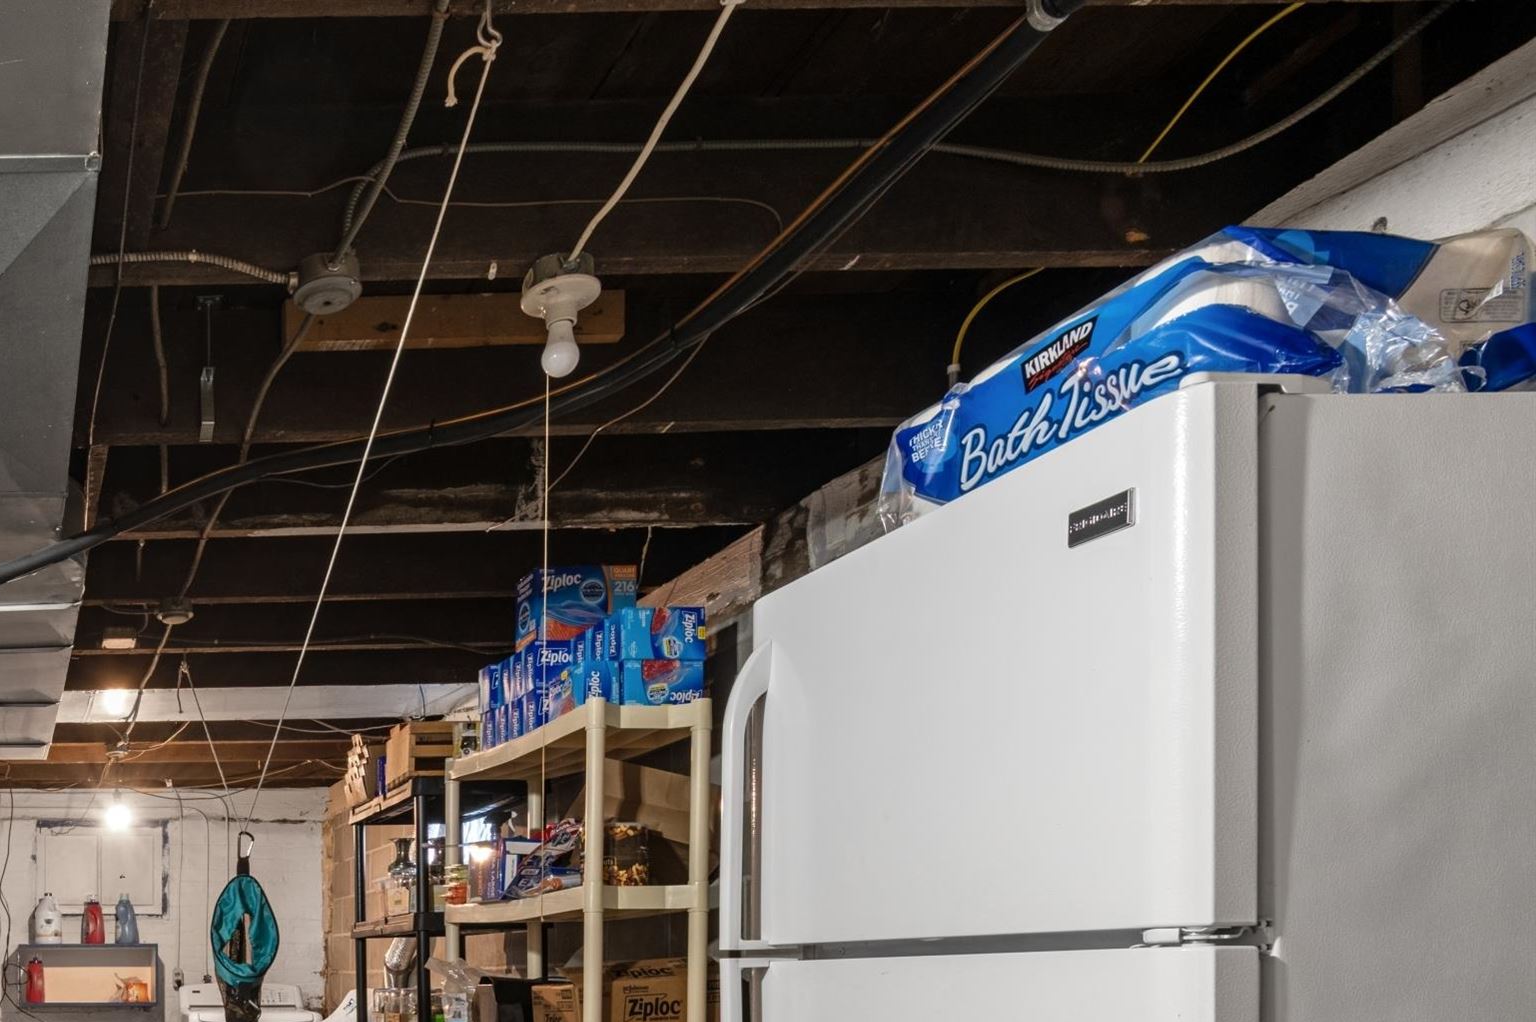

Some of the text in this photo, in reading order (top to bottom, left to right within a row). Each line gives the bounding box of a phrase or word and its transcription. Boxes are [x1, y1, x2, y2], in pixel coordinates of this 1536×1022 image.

[1025, 321, 1093, 379] KIRKLAND
[961, 356, 1183, 491] Bath Tissue
[541, 573, 582, 593] Ziploc
[614, 581, 635, 592] 216
[683, 613, 696, 643] Ziploc
[628, 997, 681, 1022] Ziploc
